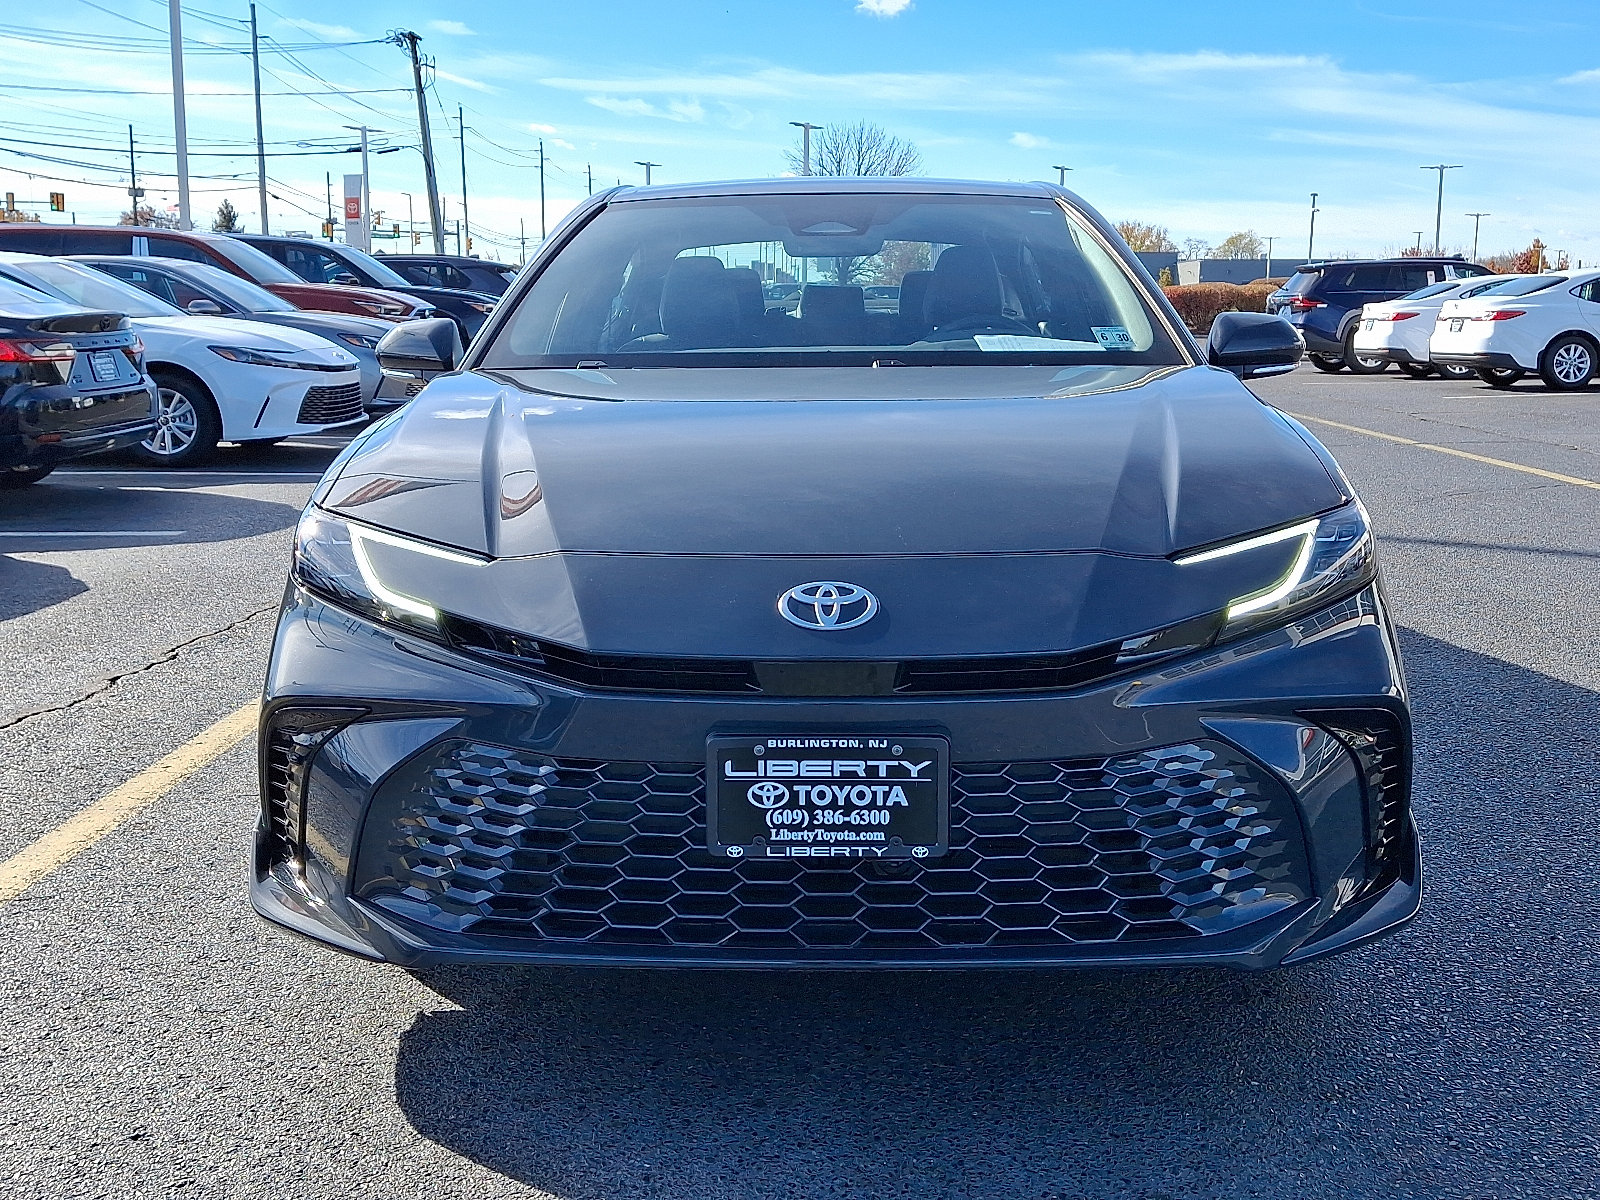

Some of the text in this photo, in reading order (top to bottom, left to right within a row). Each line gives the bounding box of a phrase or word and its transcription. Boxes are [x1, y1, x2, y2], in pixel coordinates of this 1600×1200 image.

[1101, 332, 1129, 342] 6 30
[767, 739, 888, 749] BURLINGTON, NJ
[724, 759, 933, 778] LIBERTY
[793, 784, 909, 806] TOYOTA
[765, 809, 890, 828] (609) 386-6300
[769, 828, 886, 843] LibertyToyota.com
[766, 846, 889, 857] LIBERTY
